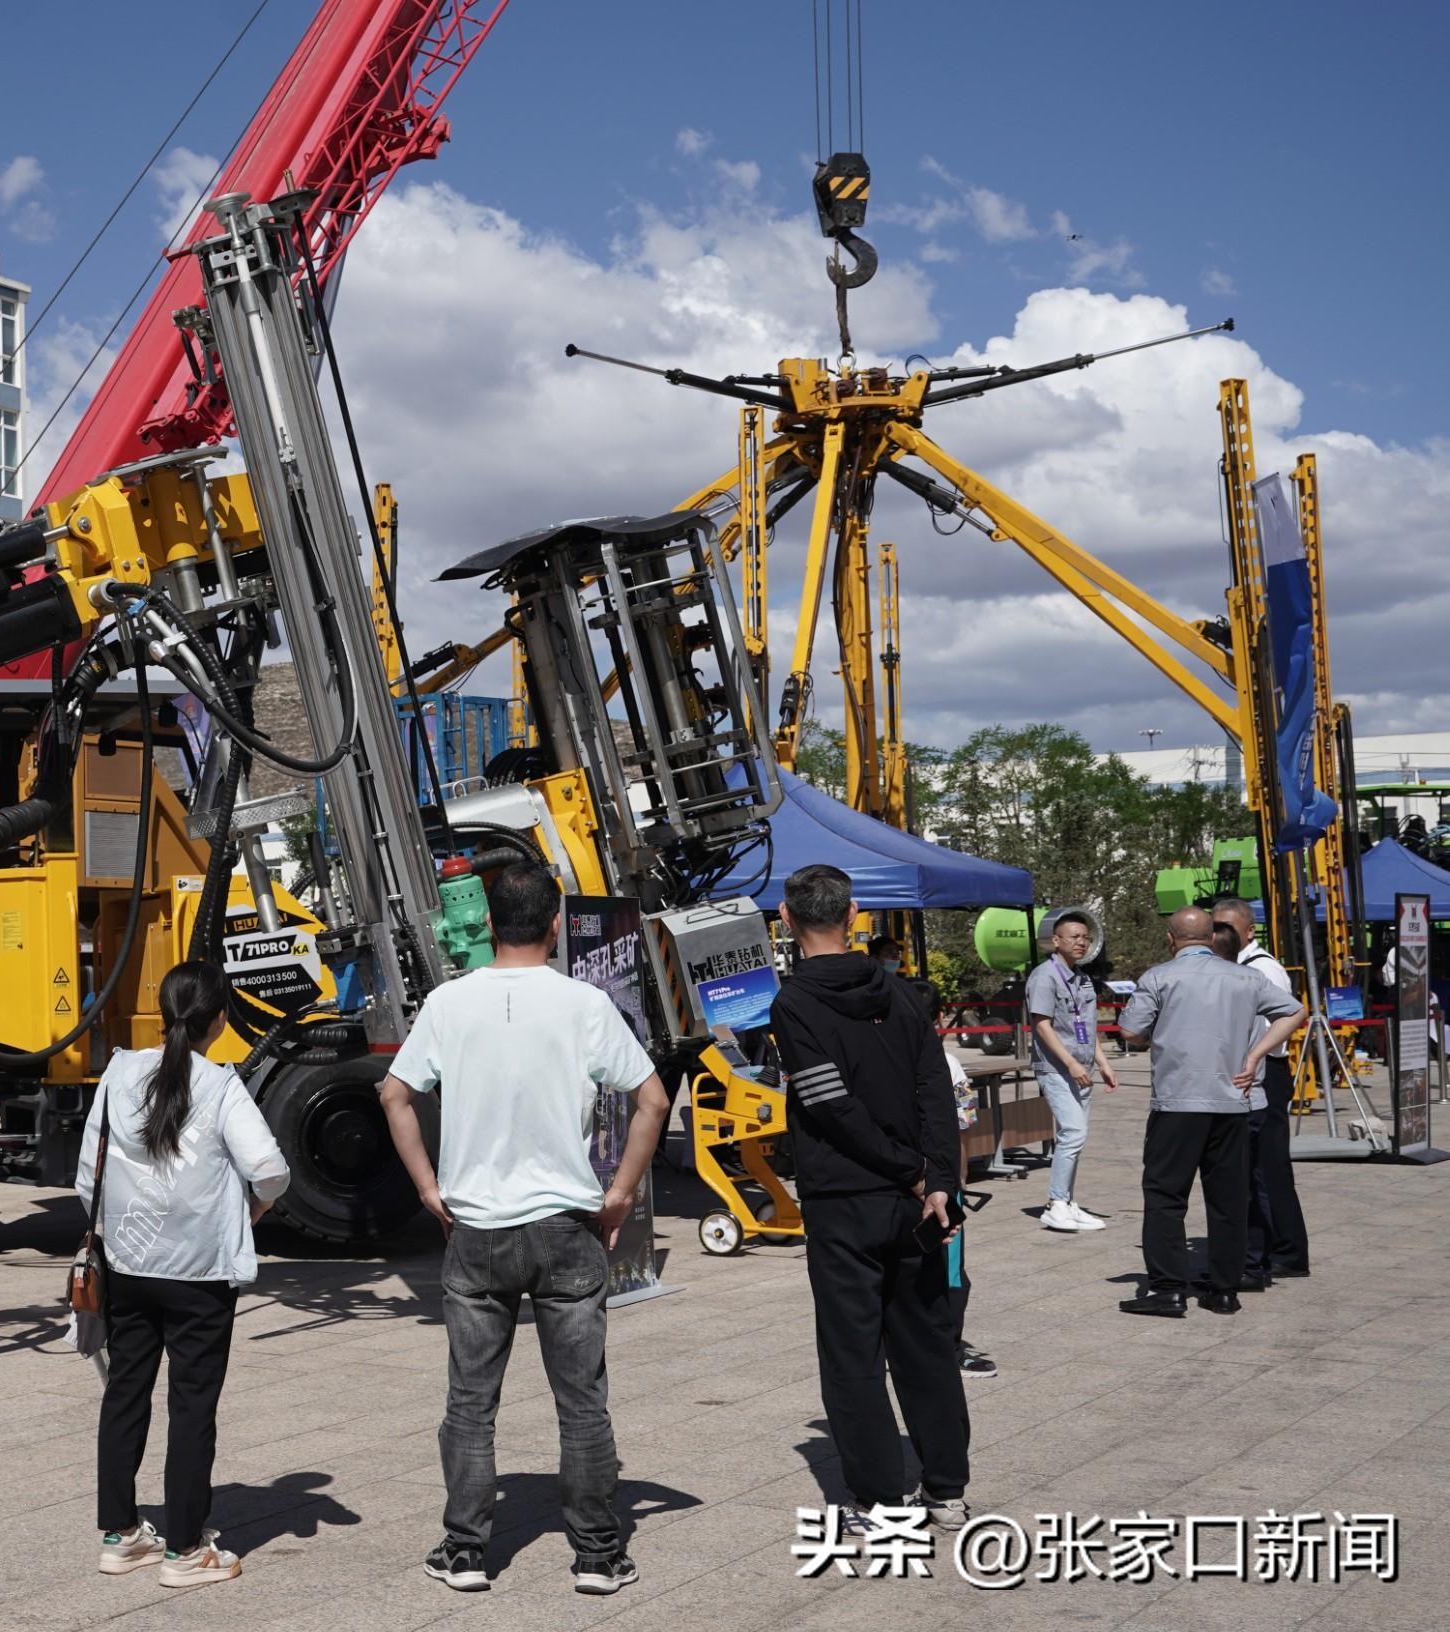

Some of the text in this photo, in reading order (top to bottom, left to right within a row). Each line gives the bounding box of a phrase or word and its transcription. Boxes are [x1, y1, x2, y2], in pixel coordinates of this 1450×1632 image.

[712, 944, 764, 967] 华泰钻机
[714, 957, 767, 979] HUATAI
